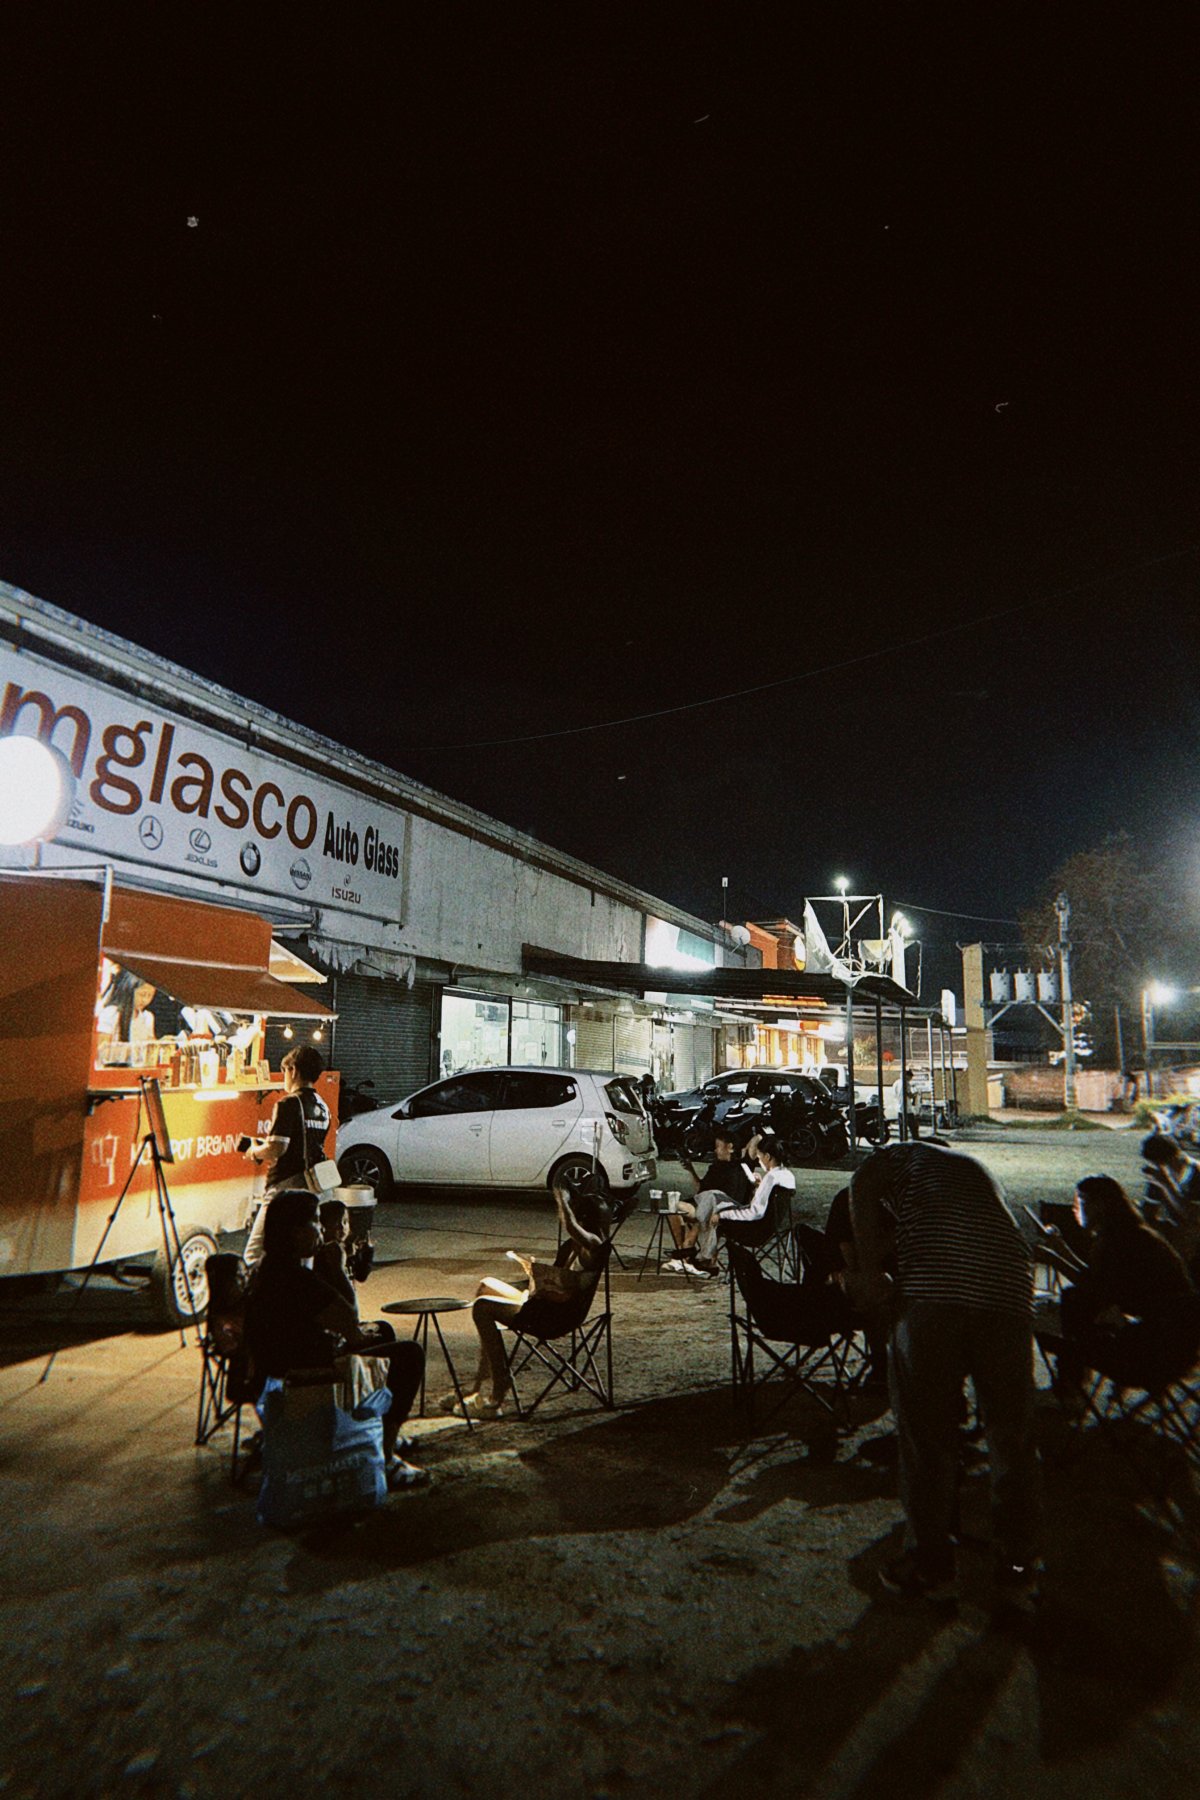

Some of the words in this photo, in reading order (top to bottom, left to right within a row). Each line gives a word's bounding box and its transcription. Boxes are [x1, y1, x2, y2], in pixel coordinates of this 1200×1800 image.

[323, 811, 359, 866] Auto
[364, 826, 400, 879] Glass
[331, 886, 362, 905] ISUZU
[170, 1137, 193, 1161] POT
